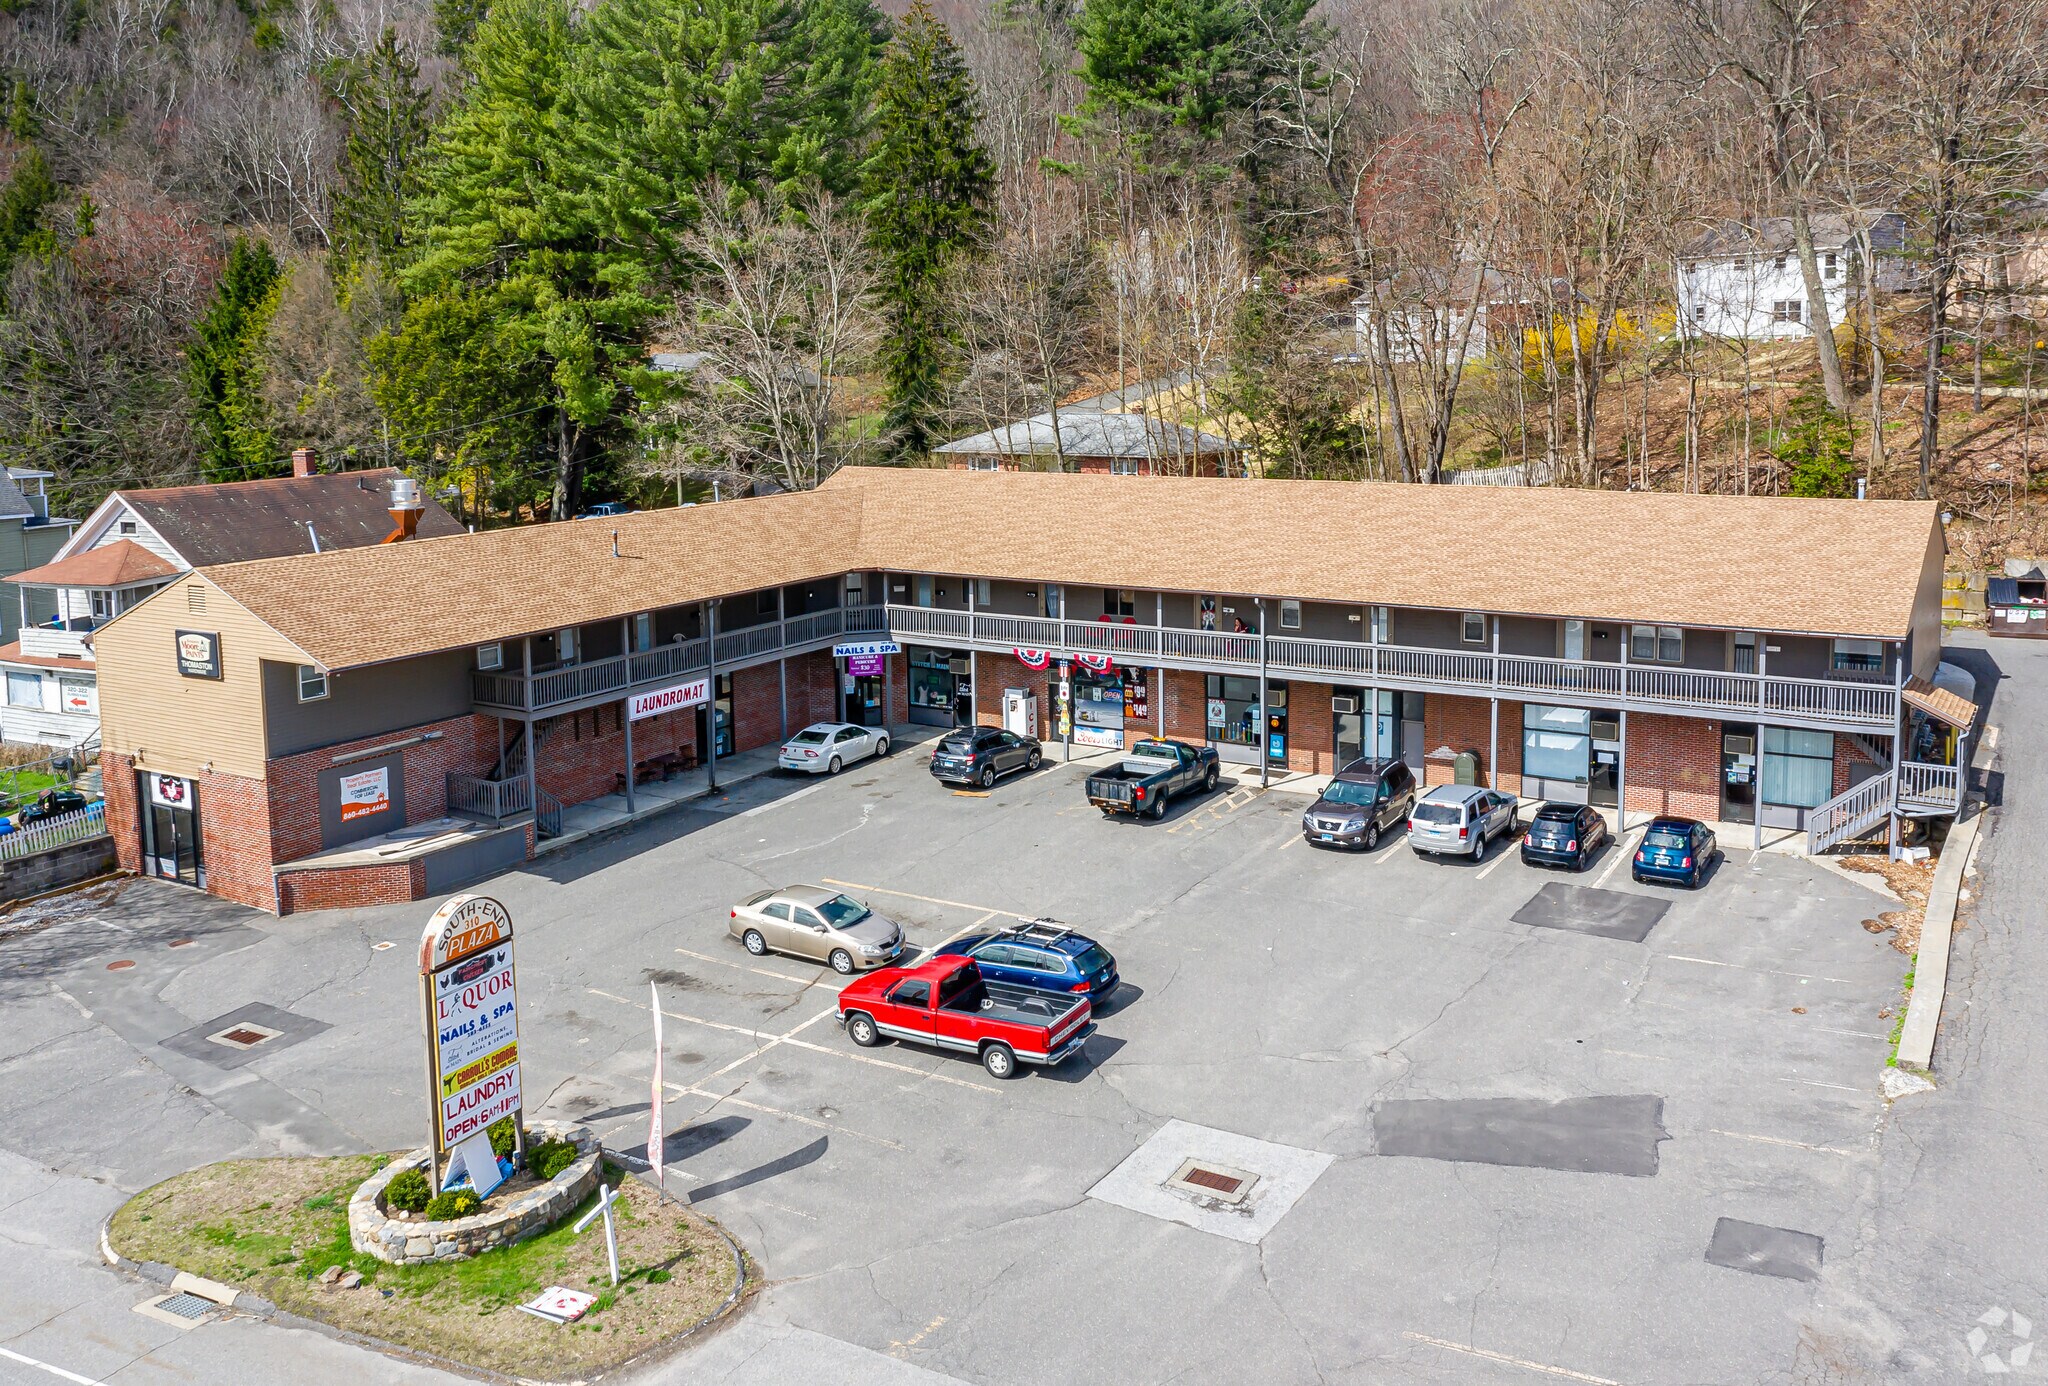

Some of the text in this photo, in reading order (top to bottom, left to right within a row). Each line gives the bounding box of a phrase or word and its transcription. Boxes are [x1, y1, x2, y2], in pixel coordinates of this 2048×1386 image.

[836, 644, 898, 655] NAILS & SPA
[181, 660, 213, 671] THOMASTON
[635, 683, 705, 714] LAUNDROMAT
[1103, 691, 1121, 699] OPEN
[1077, 732, 1123, 746] Coors LIGHT
[345, 775, 364, 783] Property
[439, 902, 505, 951] SOUTH-END
[464, 916, 480, 930] 310
[448, 923, 494, 957] PLAZA
[440, 1019, 475, 1045] NAILS
[480, 1014, 488, 1025] &
[493, 1001, 514, 1019] SPA
[466, 1044, 486, 1056] BRIDAL
[493, 1030, 513, 1043] SEWING
[456, 1057, 490, 1085] CARROLL'S
[446, 1069, 514, 1121] LAUNDRY
